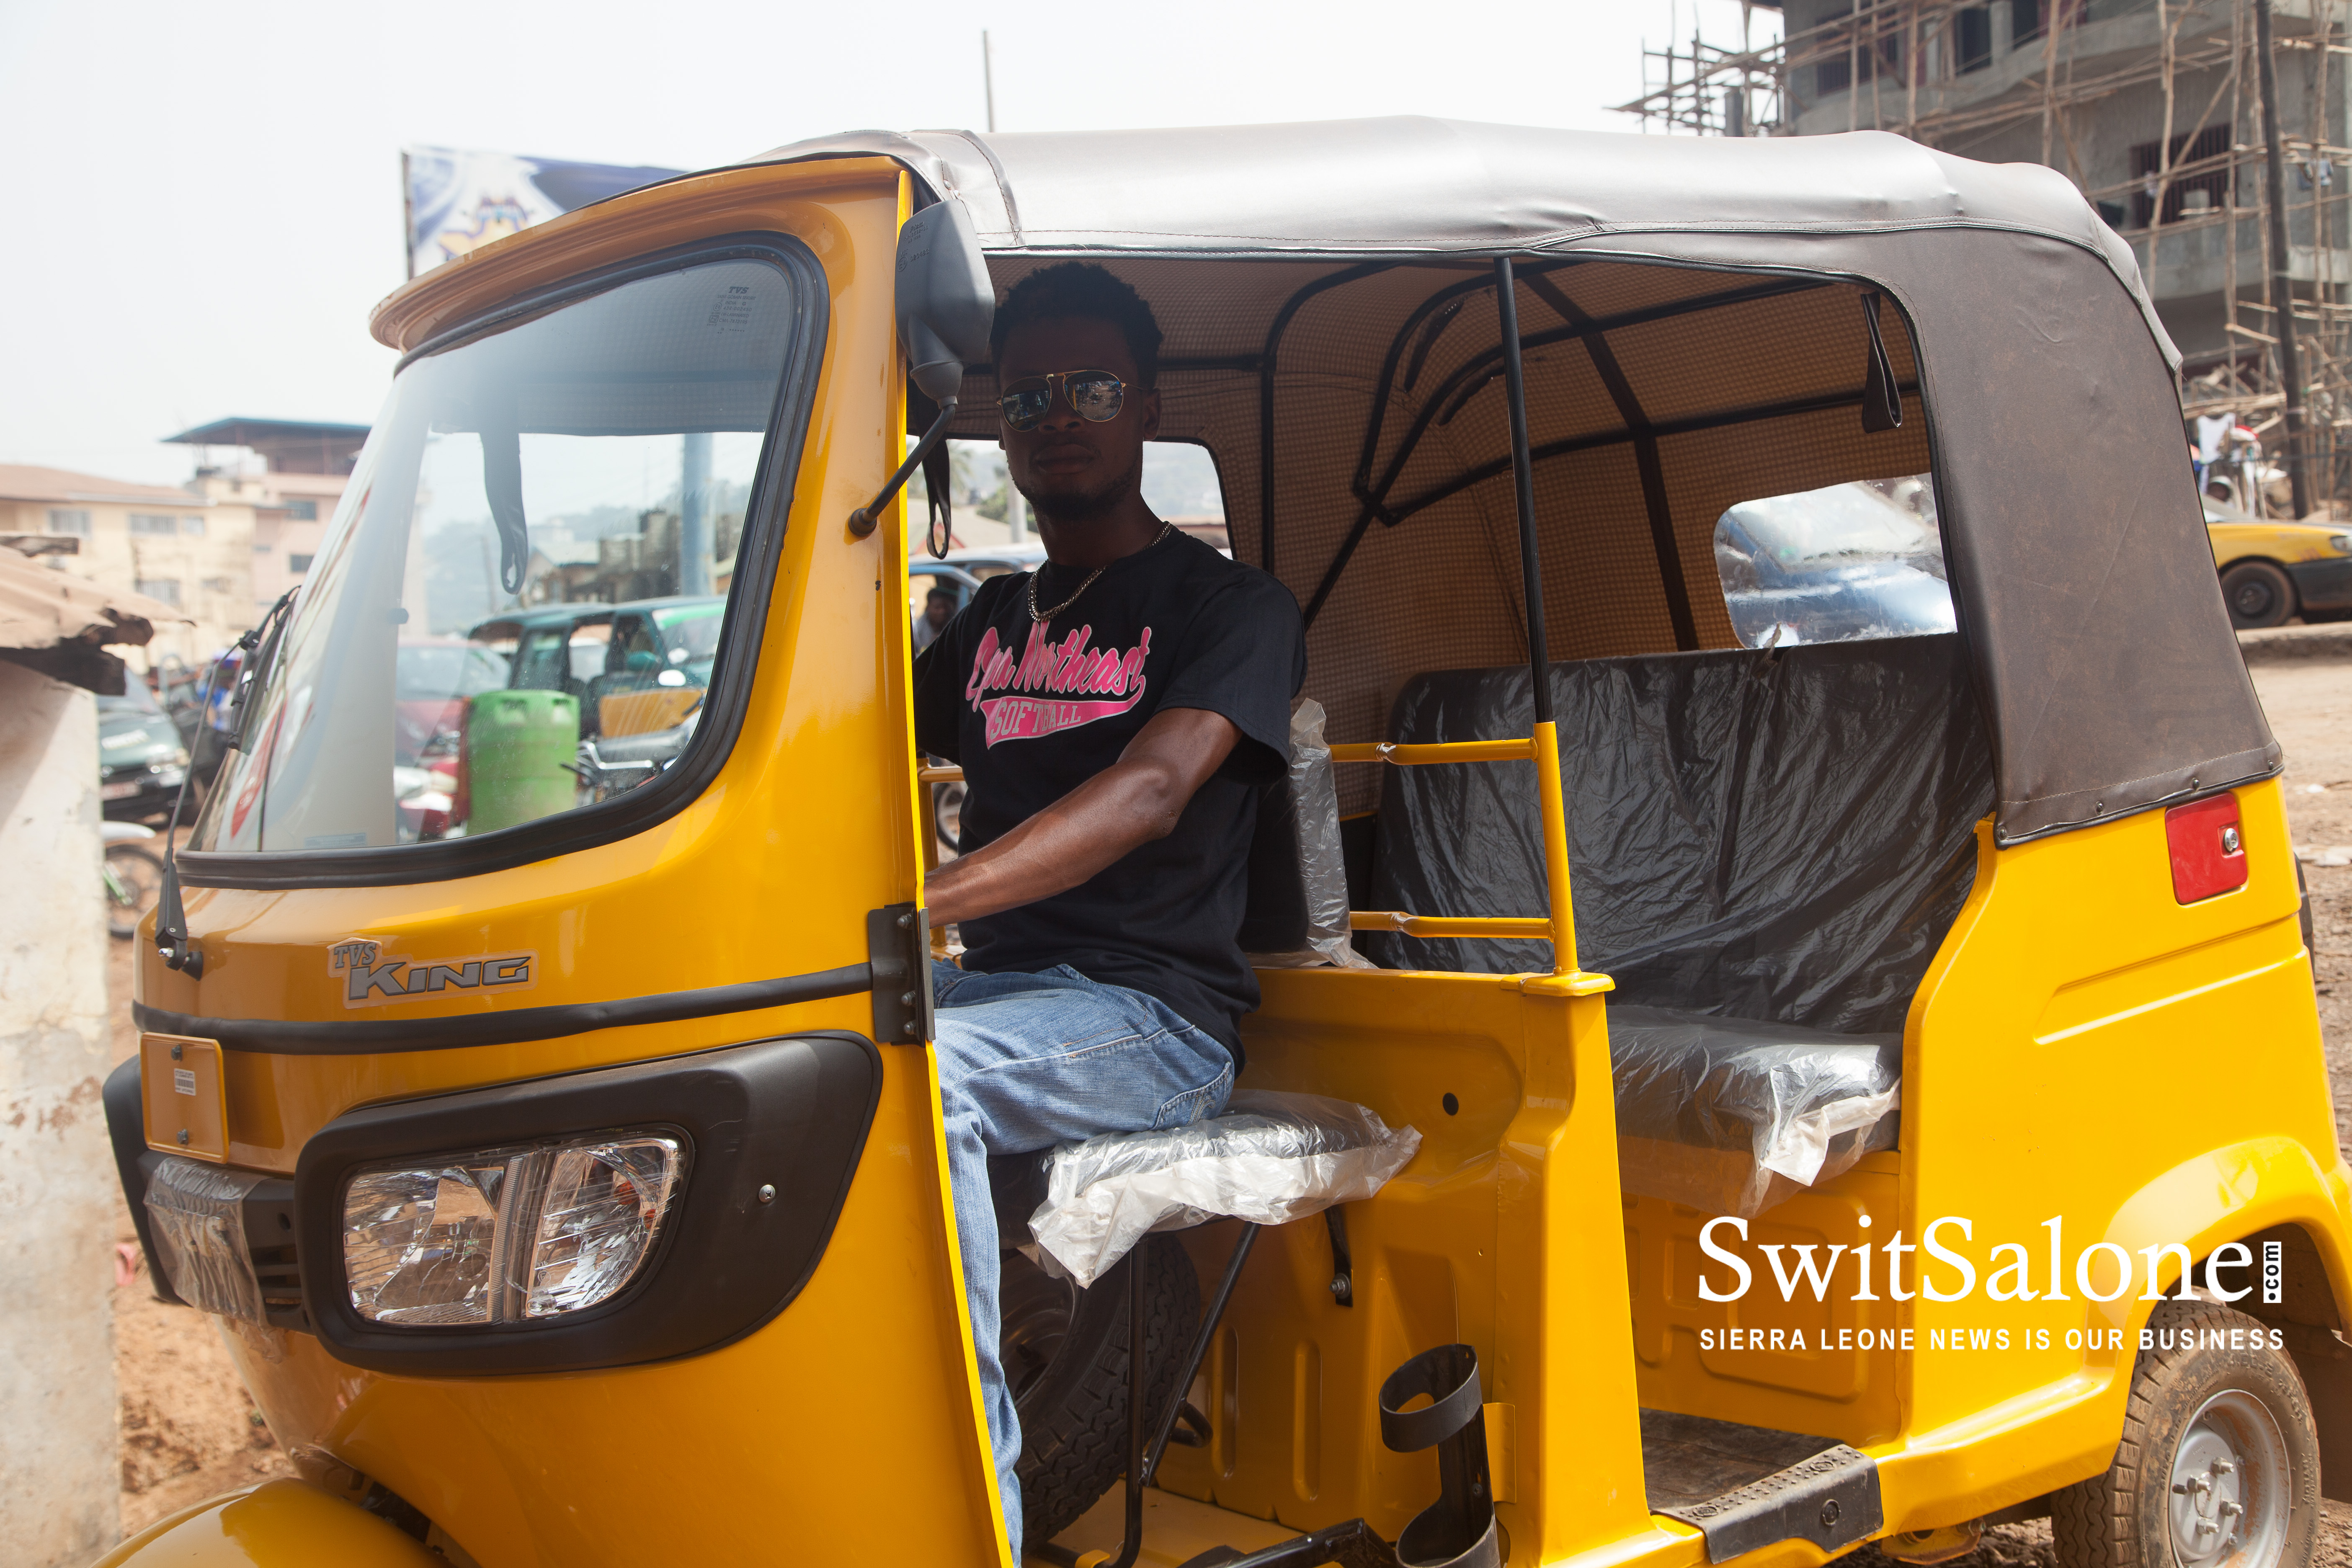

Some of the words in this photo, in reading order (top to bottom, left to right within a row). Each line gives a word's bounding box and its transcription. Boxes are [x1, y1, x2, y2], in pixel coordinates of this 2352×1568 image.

[1013, 620, 1152, 696] Northeast
[990, 701, 1081, 740] SOFTBALL
[335, 942, 377, 969] TVS
[348, 956, 531, 1001] KING
